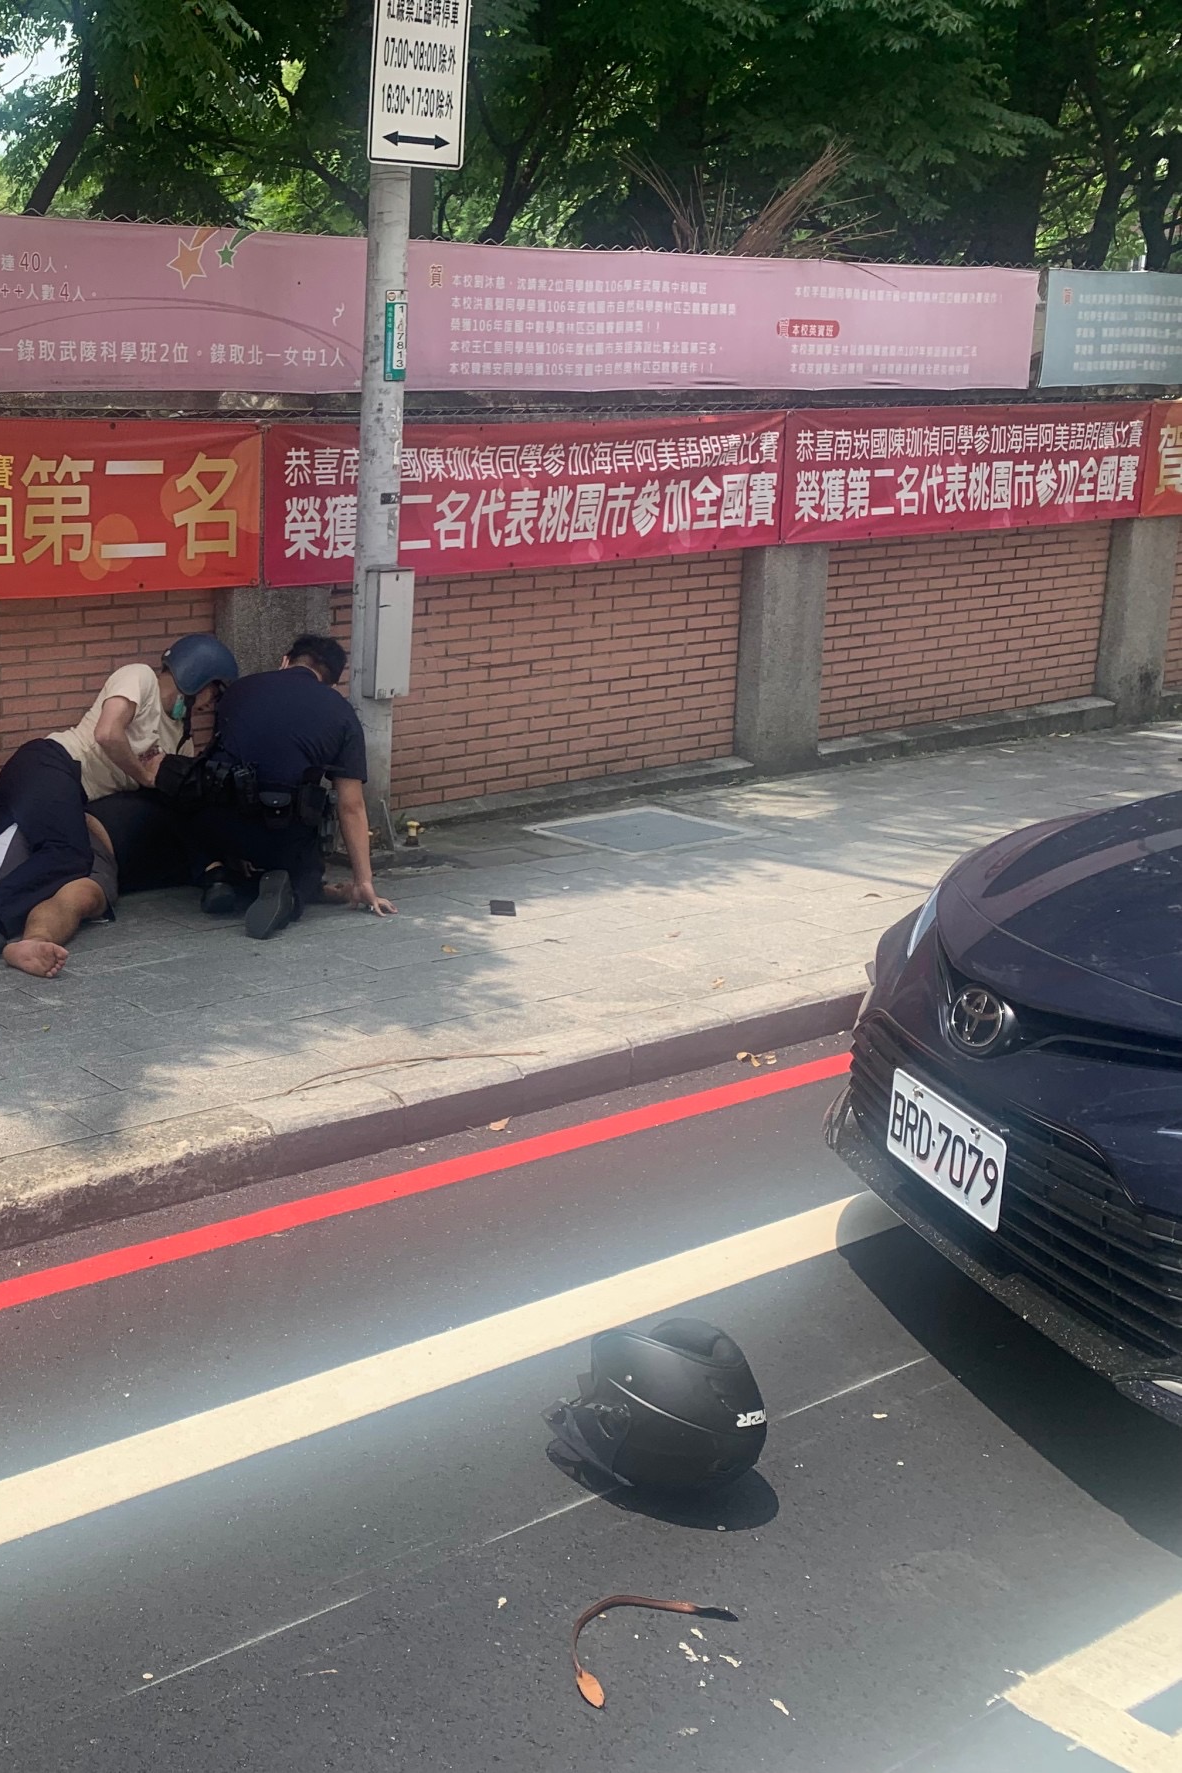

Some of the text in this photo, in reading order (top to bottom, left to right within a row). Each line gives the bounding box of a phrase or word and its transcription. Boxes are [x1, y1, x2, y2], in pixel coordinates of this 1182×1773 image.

[430, 264, 443, 288] 賀
[284, 430, 780, 486] 恭喜南國陳珈禎同學參加海岸阿美語朗讀比賽
[794, 454, 1139, 522] 榮獲第二名代表桃園市參加全國賽
[21, 452, 238, 566] 第二名
[284, 472, 778, 561] 榮獲二名代表桃園市參加全國賽
[891, 1090, 999, 1206] BRD-7079
